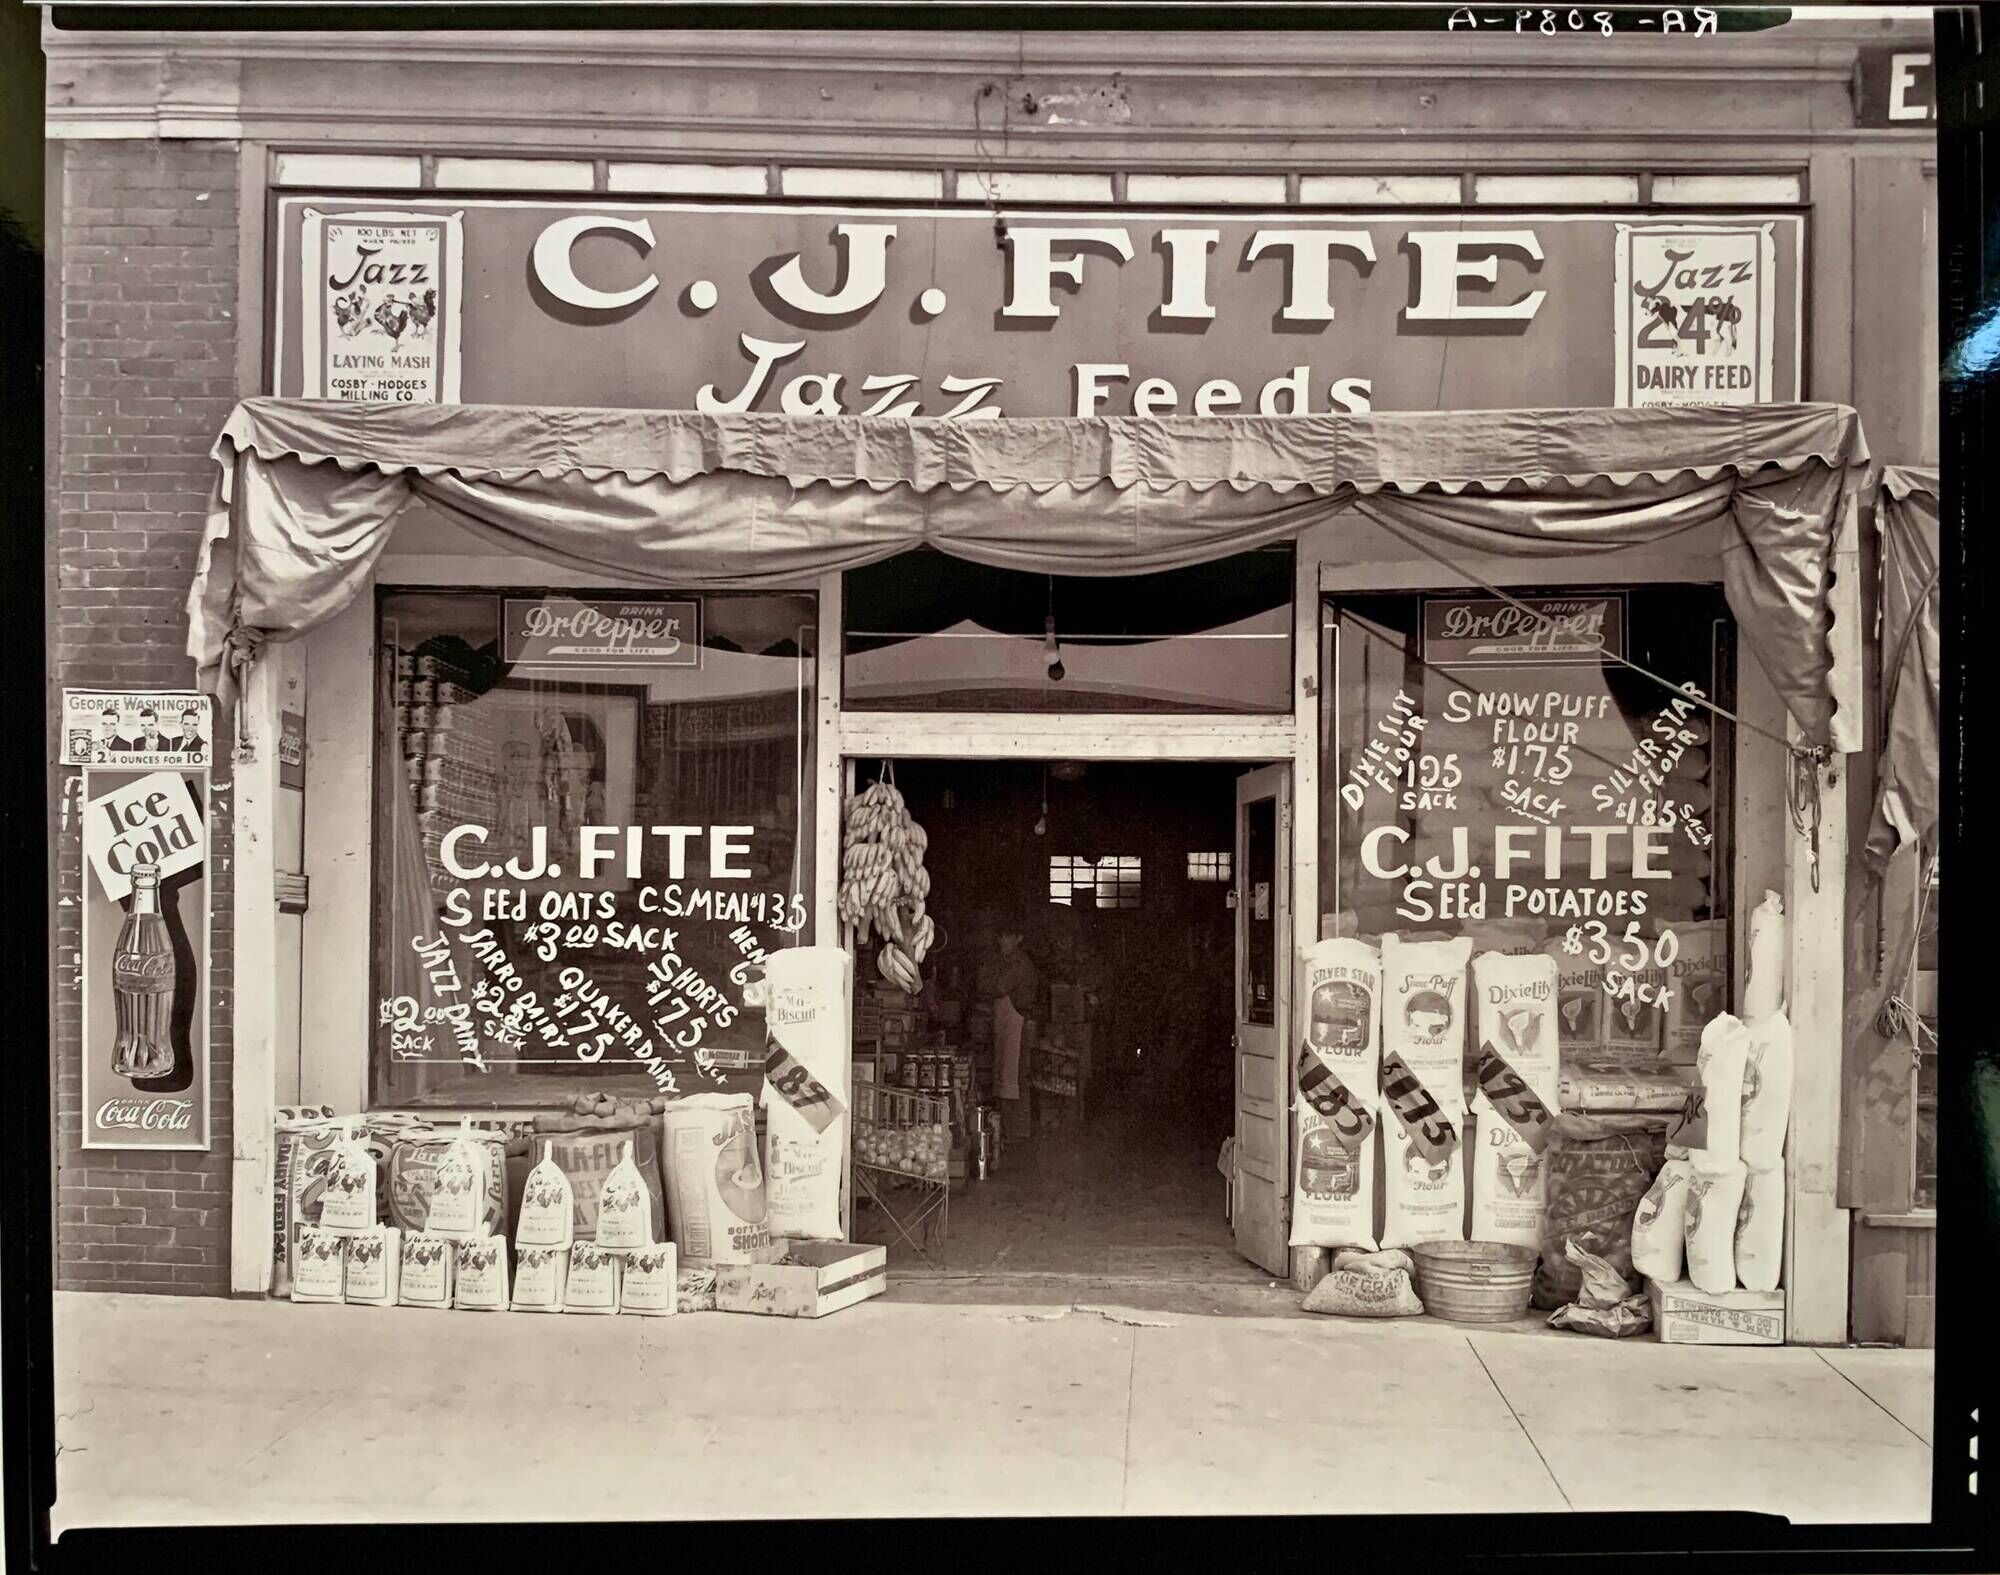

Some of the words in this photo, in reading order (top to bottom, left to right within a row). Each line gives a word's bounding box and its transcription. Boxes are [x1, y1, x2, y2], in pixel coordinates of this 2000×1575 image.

[329, 244, 429, 291] Jazz
[1002, 228, 1547, 320] FITE
[1634, 248, 1753, 298] Jazz
[332, 353, 385, 369] LAYING
[390, 354, 431, 369] MASH
[695, 332, 1003, 418] Jazz
[1074, 364, 1374, 417] Feeds
[1636, 364, 1699, 390] DAIRY
[1704, 364, 1753, 390] FEED
[340, 390, 389, 402] MILLING
[619, 606, 665, 616] DRINK
[1541, 601, 1590, 614] DRINK
[69, 696, 120, 711] GEORGE
[123, 696, 209, 712] WASHINGTON
[1442, 690, 1540, 723] SNOW
[1543, 691, 1612, 719] PUFF
[1493, 718, 1579, 745] FLOUR
[1591, 738, 1662, 812] SILVER
[1652, 681, 1707, 741] STAR
[120, 755, 160, 765] OUNCES
[163, 755, 183, 765] FOR
[1374, 715, 1429, 794] FLOUR
[100, 790, 170, 838] Ice
[1400, 791, 1457, 811] SACK
[1500, 779, 1567, 819] SACK
[106, 812, 198, 876] Cold
[579, 825, 755, 880] FITE
[1494, 825, 1675, 880] FITE
[539, 890, 617, 921] OATS
[1504, 884, 1649, 918] POTATOES
[602, 920, 680, 953] SACK
[646, 952, 740, 1029] SHORTS
[1312, 966, 1348, 987] SILVER
[1351, 967, 1375, 992] STAR
[1601, 970, 1676, 1013] SACK
[411, 930, 462, 997] JAZZ
[443, 1002, 491, 1073] DAIRY
[483, 1019, 528, 1051] SACK
[516, 991, 571, 1048] DAIRY
[391, 1033, 436, 1051] SACK
[633, 1038, 681, 1093] DAIRY
[95, 1098, 194, 1130] Coca-Cola
